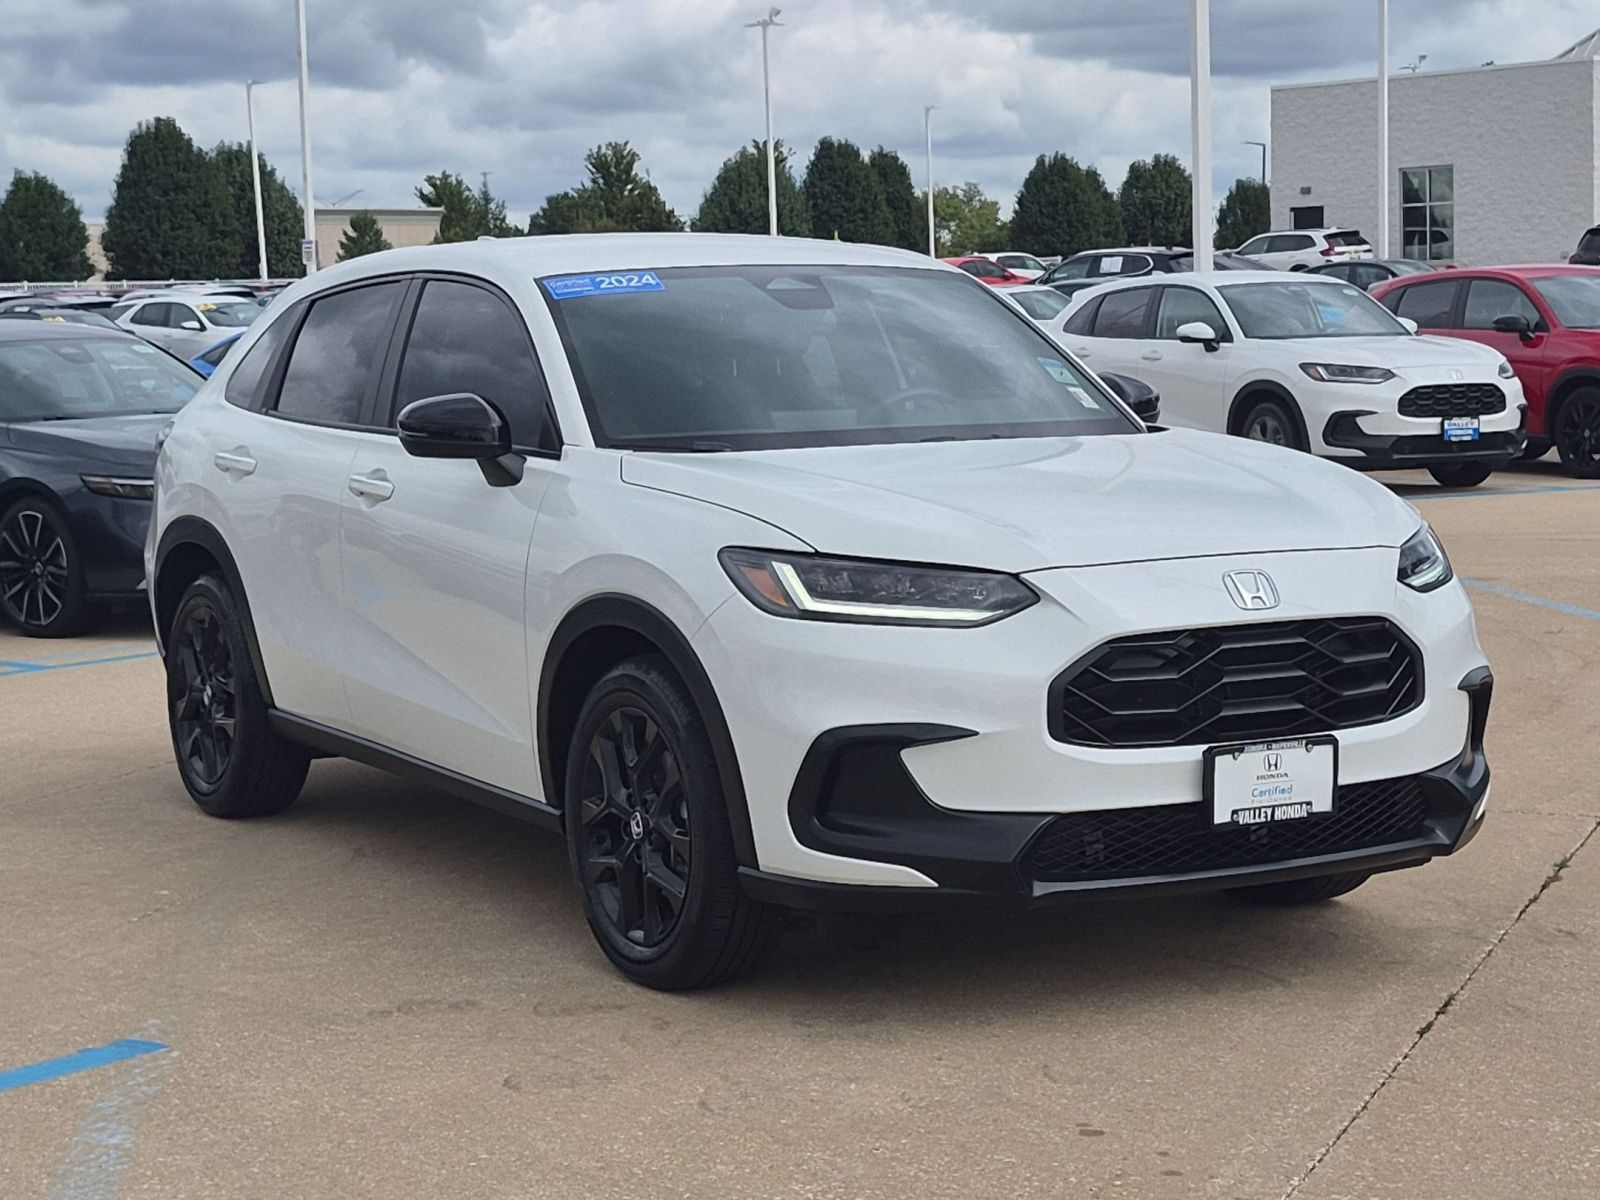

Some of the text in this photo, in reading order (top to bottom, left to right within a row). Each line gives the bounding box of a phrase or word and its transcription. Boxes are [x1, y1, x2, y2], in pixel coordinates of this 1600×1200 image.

[595, 274, 657, 289] 2024
[1256, 772, 1289, 781] HONDA
[1251, 784, 1293, 798] Certified
[1238, 803, 1308, 825] VALLEY HONDA
